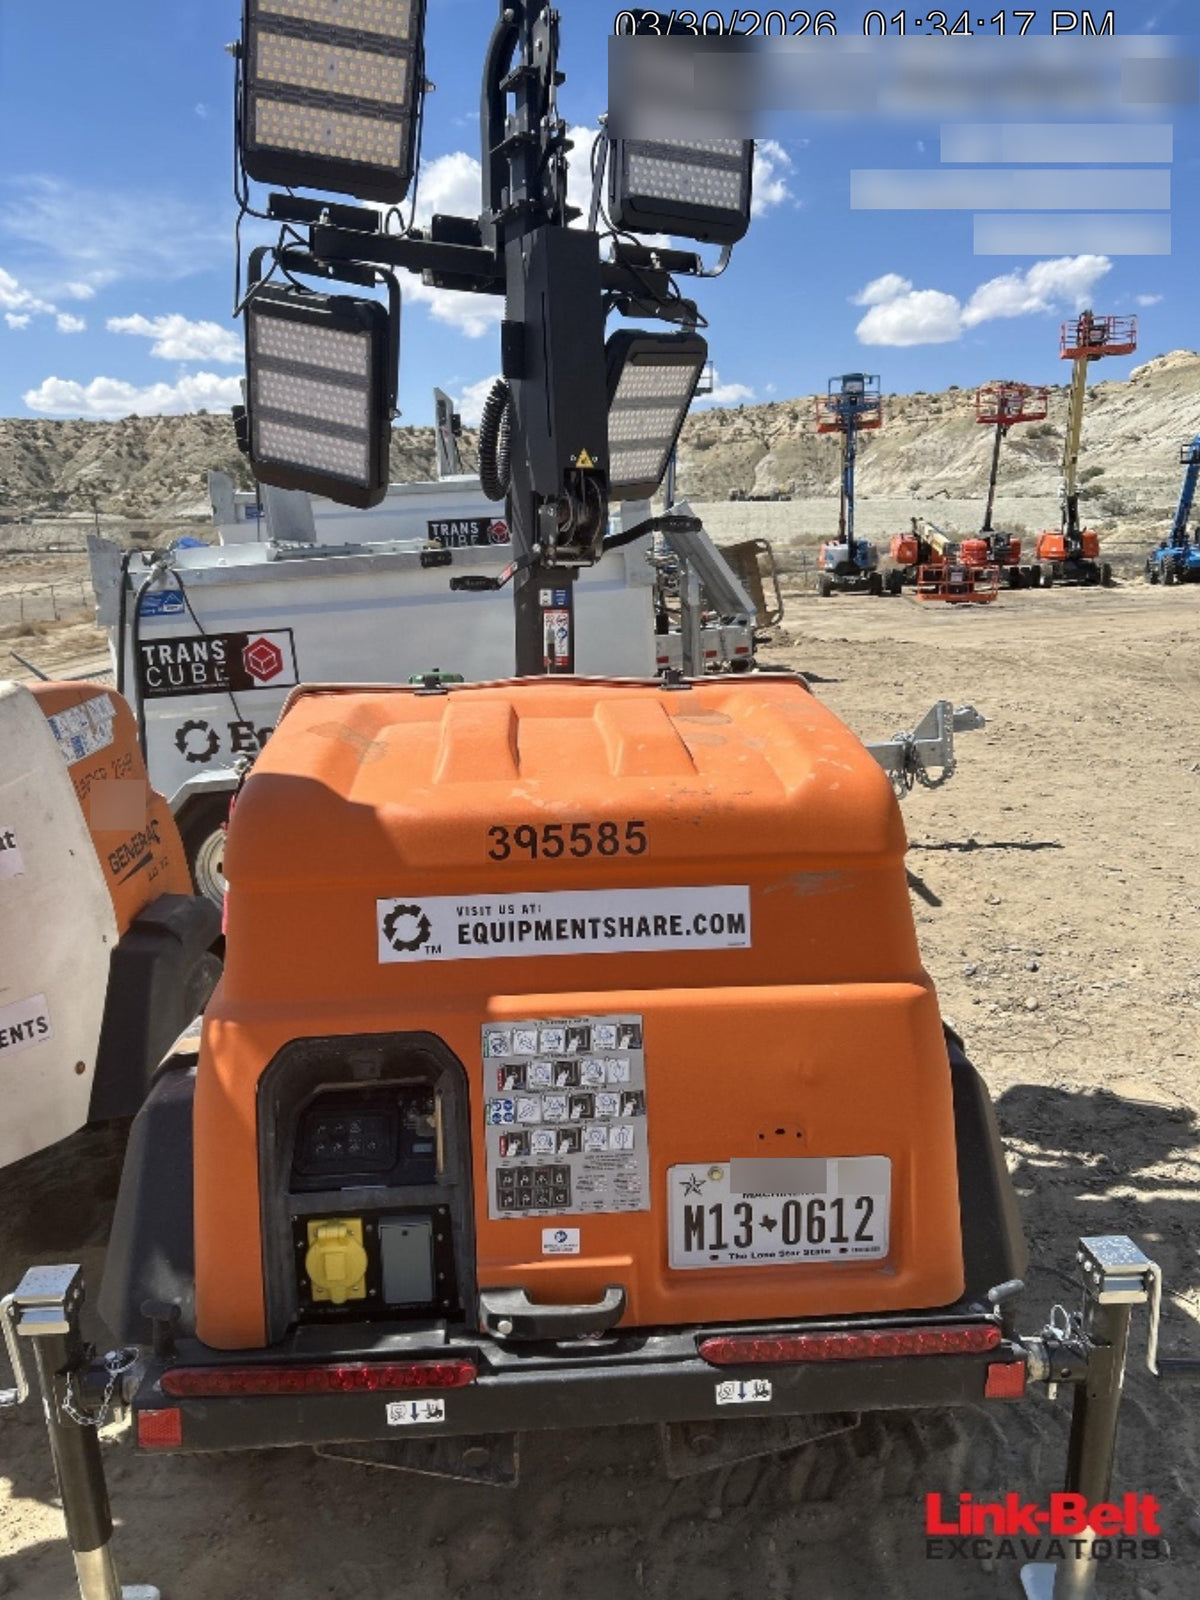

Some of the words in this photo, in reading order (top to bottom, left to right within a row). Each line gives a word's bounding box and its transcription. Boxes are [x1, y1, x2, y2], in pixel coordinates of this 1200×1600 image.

[431, 522, 479, 536] TRANS
[141, 640, 225, 665] TRANS
[146, 662, 230, 687] CUBE
[487, 821, 648, 861] 395585
[456, 906, 491, 917] VISIT
[499, 904, 515, 915] US
[522, 903, 542, 915] AT:
[458, 913, 746, 945] EQUIPMENTSHARE.COM
[425, 945, 442, 954] TM
